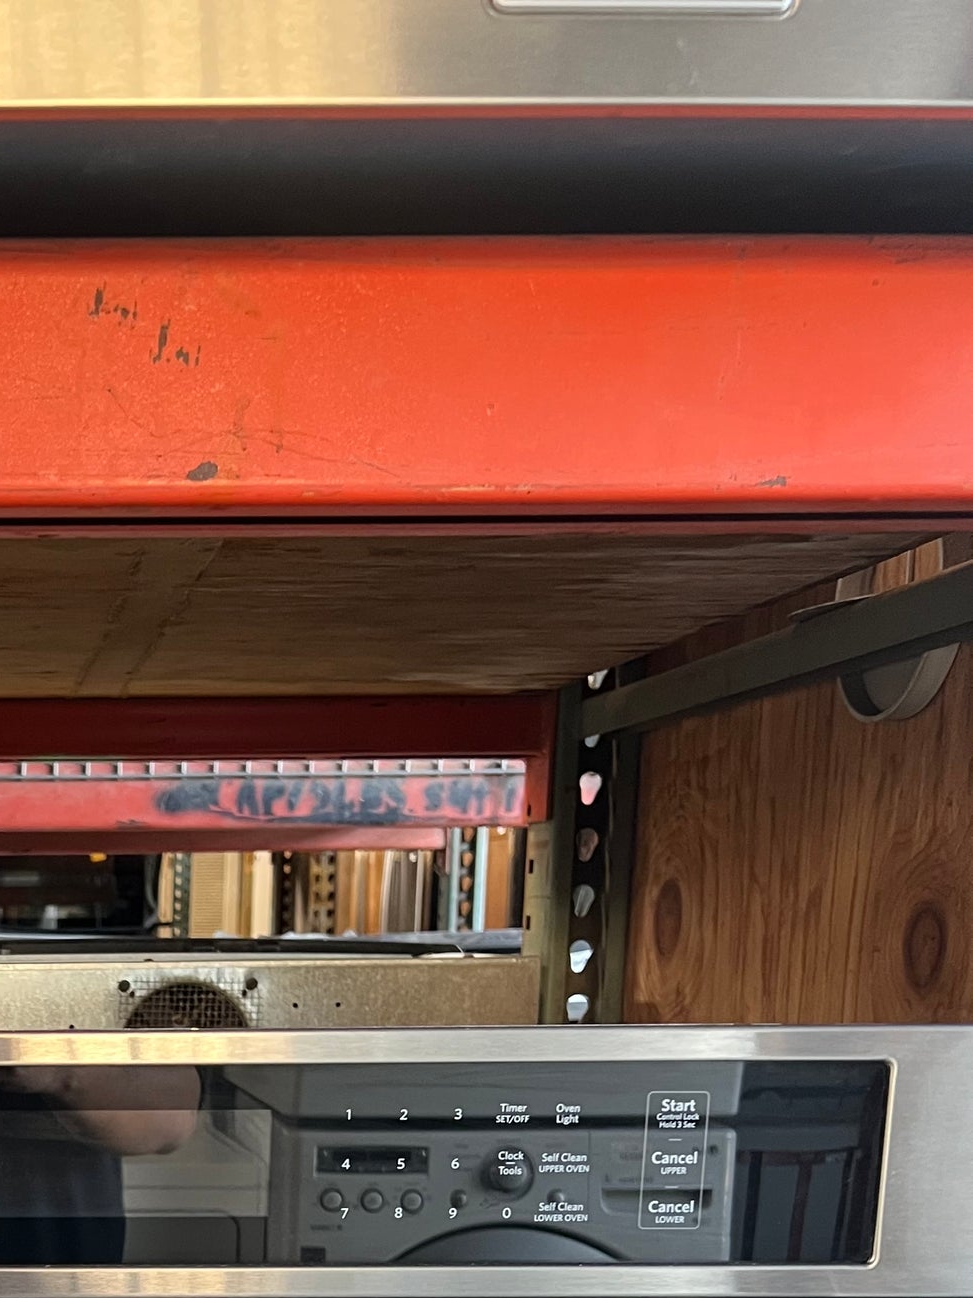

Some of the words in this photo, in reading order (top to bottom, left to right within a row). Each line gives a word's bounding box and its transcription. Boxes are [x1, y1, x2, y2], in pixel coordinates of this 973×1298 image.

[499, 1103, 528, 1113] Timer
[555, 1103, 581, 1113] Oven
[661, 1098, 696, 1112] Start
[345, 1108, 352, 1121] 1
[399, 1108, 409, 1121] 2
[454, 1107, 463, 1120] 3
[495, 1114, 530, 1124] SET/OFF
[555, 1113, 579, 1126] Light
[656, 1112, 683, 1121] Control
[683, 1112, 700, 1121] Lock
[658, 1120, 677, 1129] Hold
[682, 1120, 696, 1129] Sec
[497, 1150, 524, 1161] Clock
[541, 1152, 560, 1163] Self
[560, 1152, 588, 1162] Clean
[651, 1151, 698, 1165] Cancel
[341, 1158, 351, 1170] 4
[396, 1157, 406, 1170] 5
[450, 1157, 460, 1170] 6
[538, 1164, 565, 1173] UPPER
[565, 1164, 590, 1173] OVEN
[497, 1165, 523, 1176] Tools
[660, 1166, 687, 1175] UPPER
[538, 1202, 557, 1212] Self
[557, 1201, 584, 1212] Clean
[648, 1200, 695, 1213] Cancel
[340, 1207, 349, 1219] 7
[394, 1207, 403, 1219] 8
[448, 1207, 458, 1219] 9
[502, 1207, 512, 1219] 0
[533, 1213, 563, 1222] LOWER
[564, 1213, 589, 1222] OVEN
[655, 1215, 685, 1224] LOWER
